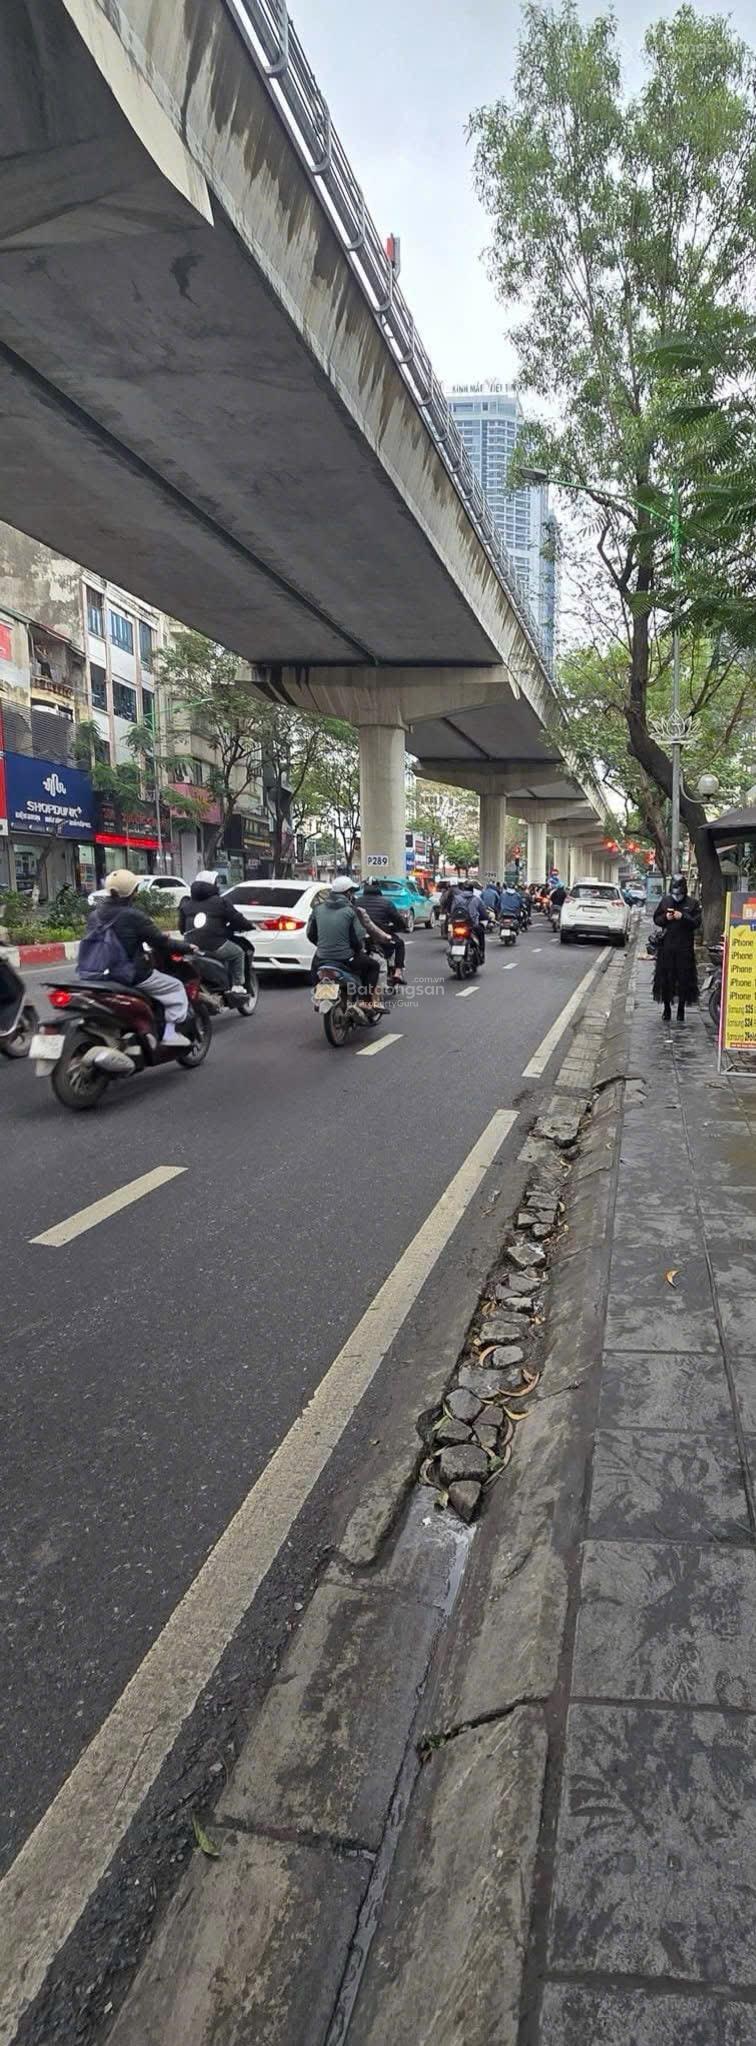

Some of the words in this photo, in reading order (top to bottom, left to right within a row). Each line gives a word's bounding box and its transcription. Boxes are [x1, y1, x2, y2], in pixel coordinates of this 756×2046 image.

[26, 800, 79, 818] SHOPDUNK
[367, 856, 388, 866] P289
[732, 939, 754, 947] iPhone
[731, 952, 753, 960] iPhone
[731, 965, 753, 974] iPhone
[730, 978, 752, 987] iPhone
[730, 991, 752, 1000] iPhone
